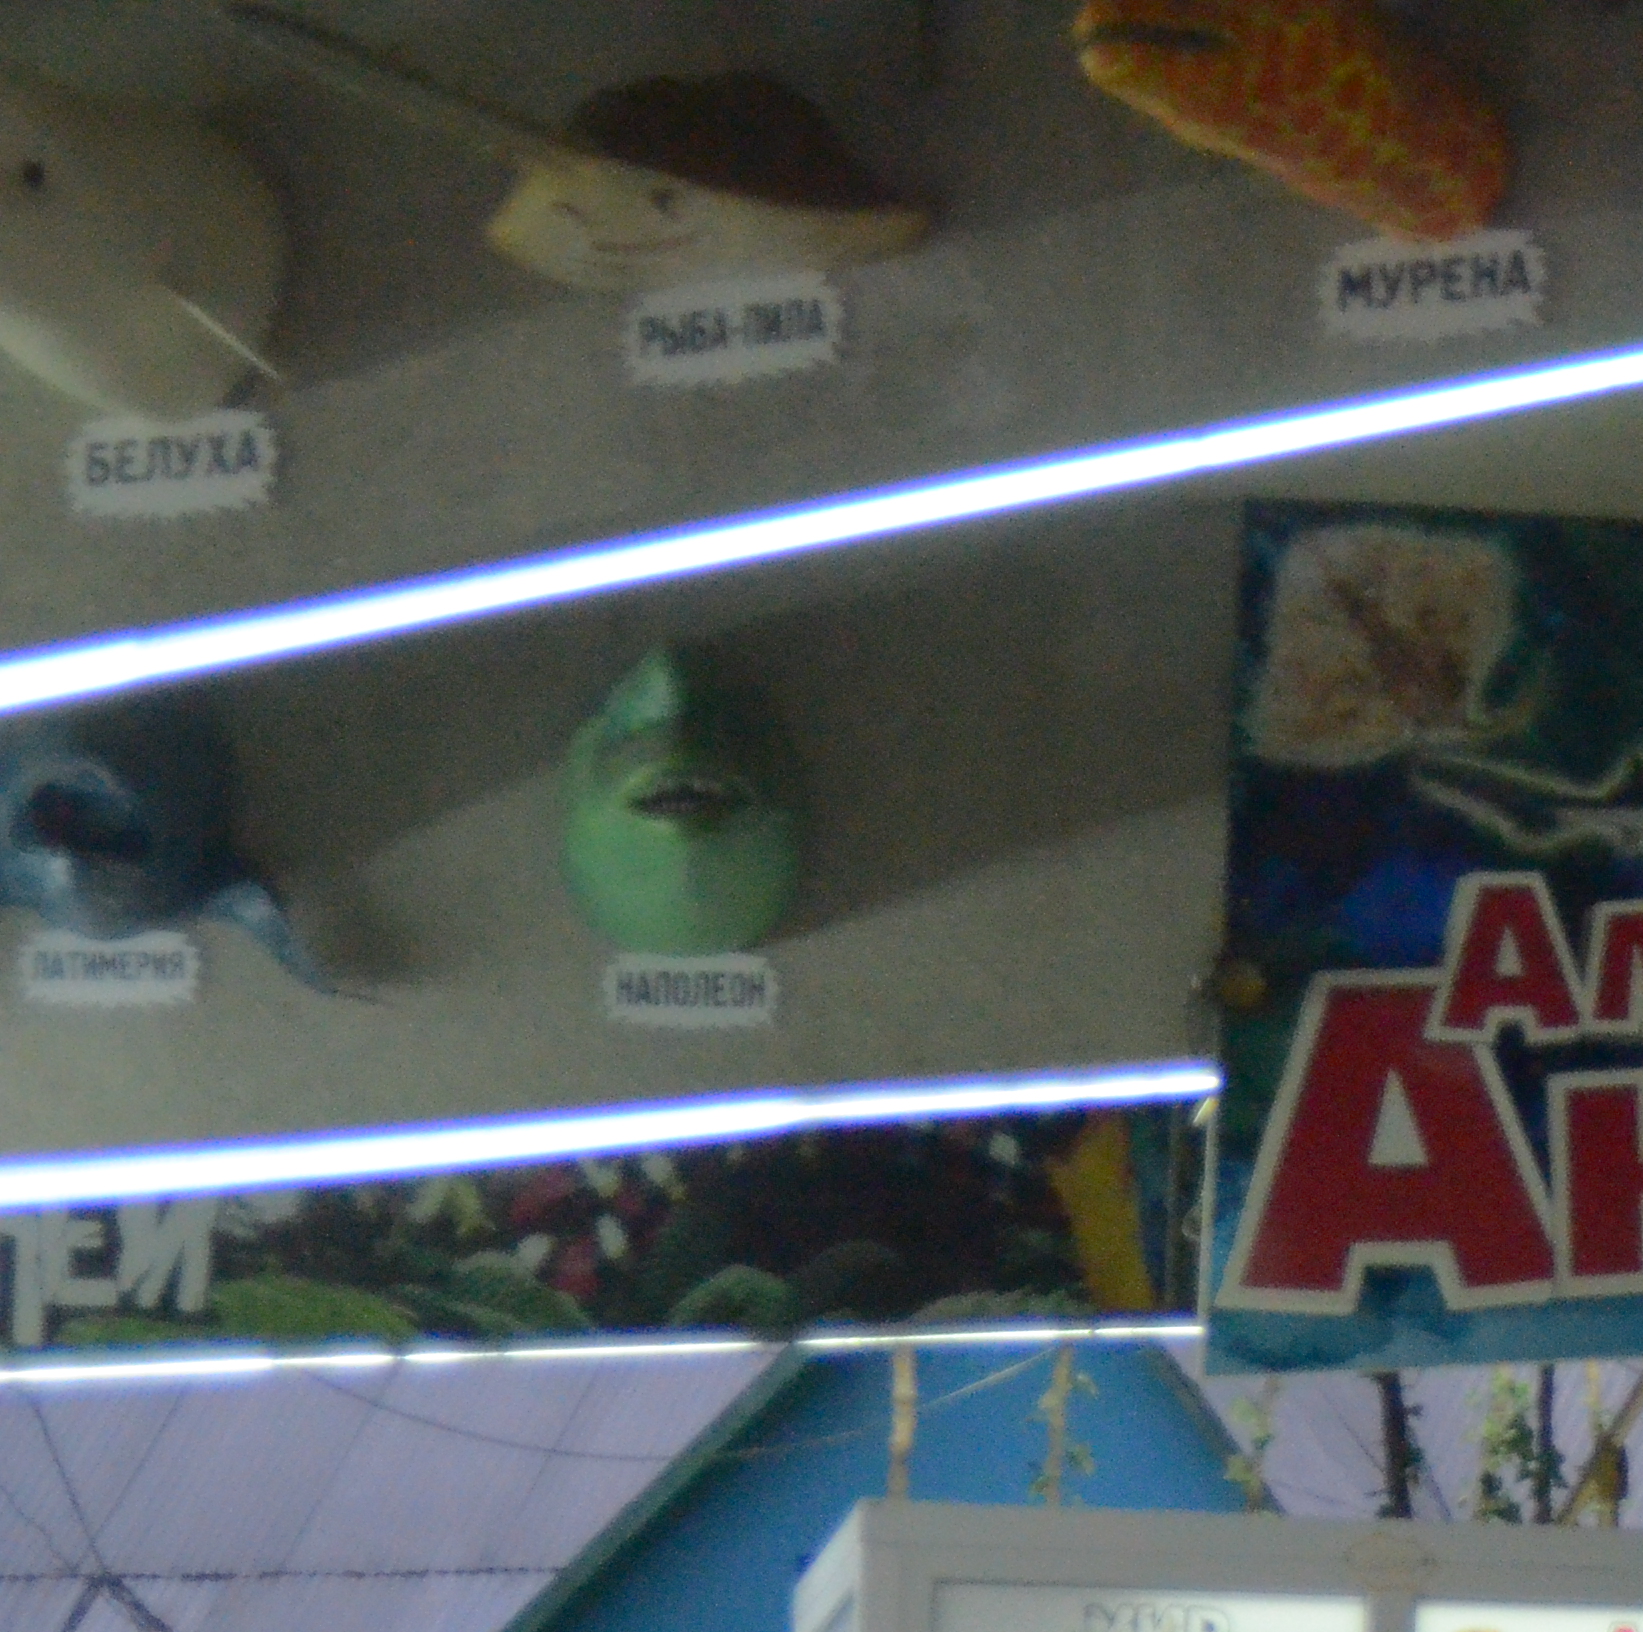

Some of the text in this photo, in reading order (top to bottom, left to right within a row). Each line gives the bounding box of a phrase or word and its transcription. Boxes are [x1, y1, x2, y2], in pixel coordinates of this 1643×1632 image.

[1337, 249, 1532, 313] МУРЕНА
[638, 299, 824, 357] РЫБА-ПИЛА
[84, 430, 260, 487] БЕЛУХА
[34, 949, 187, 982] ЛАТИМЕРИЯ
[616, 970, 766, 1008] НАПОЛЕОН
